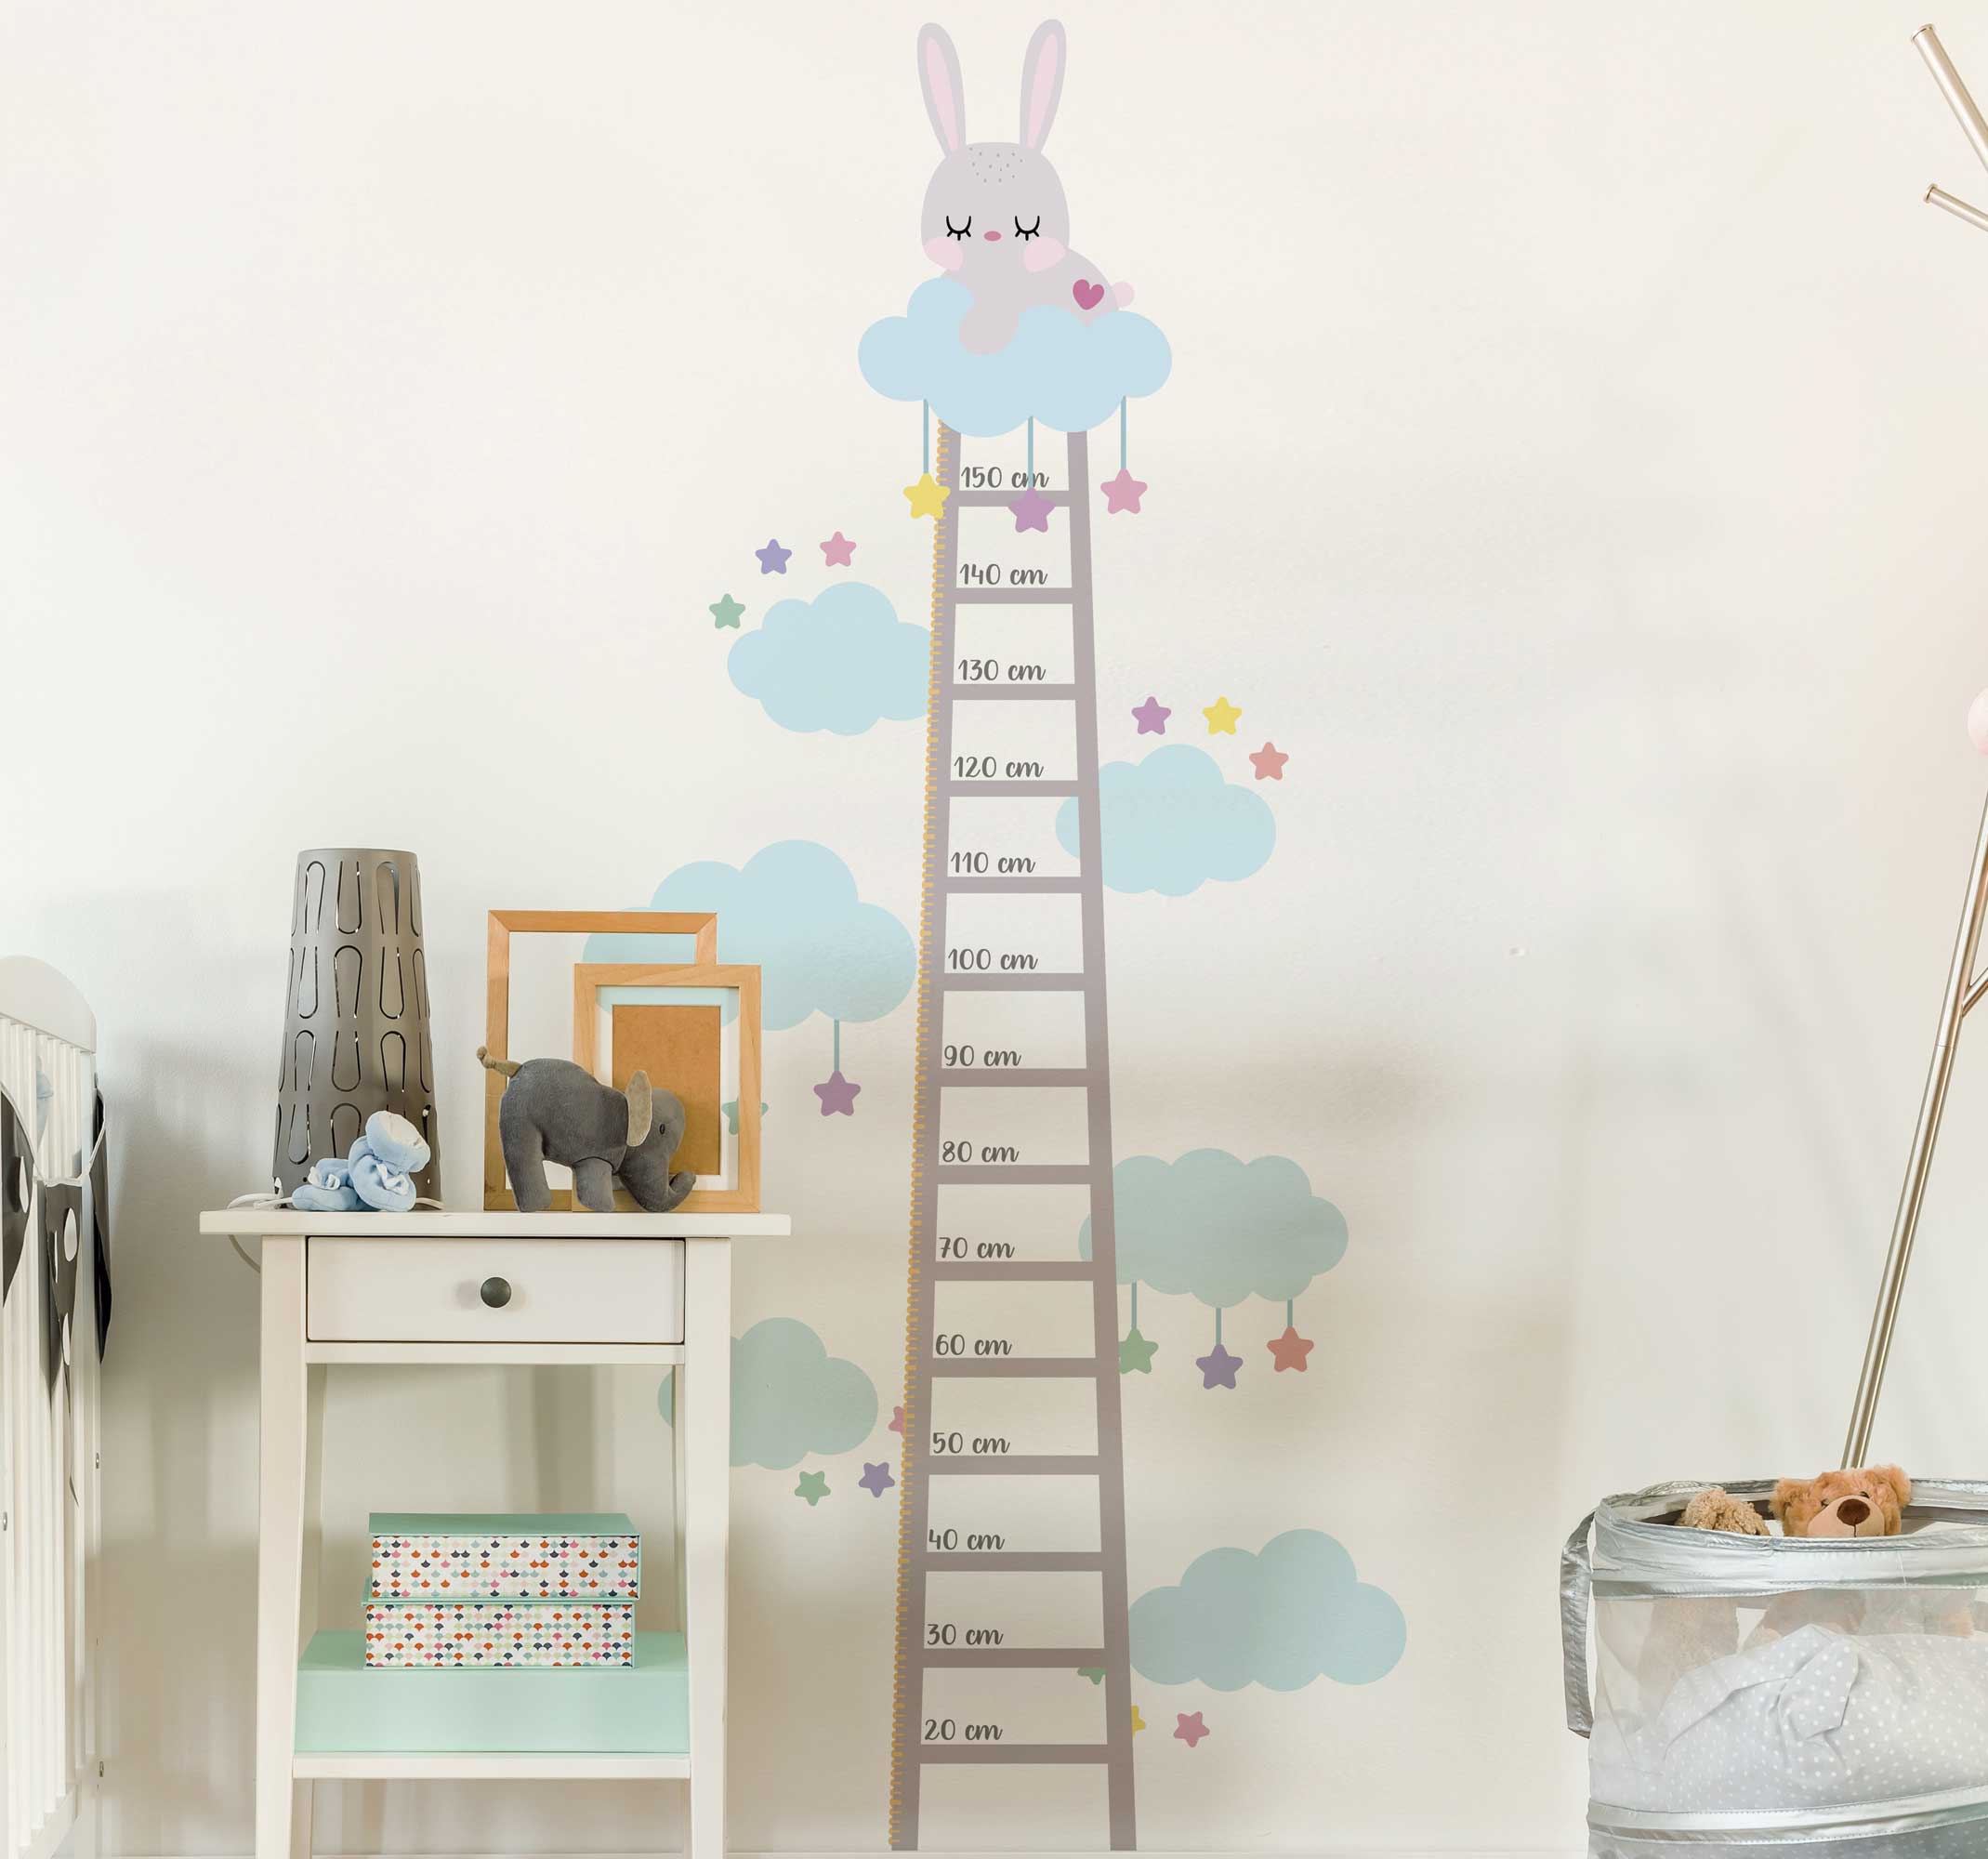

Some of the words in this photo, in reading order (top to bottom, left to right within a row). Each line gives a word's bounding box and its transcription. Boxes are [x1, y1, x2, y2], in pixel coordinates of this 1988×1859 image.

[961, 468, 1002, 488] 150
[1011, 472, 1049, 488] cm
[959, 563, 1001, 585] 140
[1009, 569, 1047, 585] cm
[958, 659, 999, 680] 130
[1007, 665, 1047, 680] cm
[954, 757, 997, 777] 120
[1006, 761, 1044, 777] cm
[951, 851, 989, 873] 110
[997, 857, 1035, 873] cm
[948, 948, 991, 969] 100
[1000, 954, 1038, 969] cm
[944, 1045, 975, 1067] 90
[983, 1050, 1021, 1067] cm
[942, 1140, 972, 1163] 80
[981, 1146, 1020, 1163] cm
[939, 1236, 968, 1259] 70
[977, 1242, 1015, 1259] cm
[935, 1334, 966, 1355] 60
[974, 1339, 1013, 1356] cm
[933, 1432, 963, 1454] 50
[972, 1437, 1011, 1454] cm
[928, 1529, 958, 1550] 40
[967, 1534, 1006, 1550] cm
[927, 1623, 956, 1645] 30
[965, 1628, 1004, 1645] cm
[924, 1719, 956, 1740] 20
[965, 1724, 1004, 1741] cm
